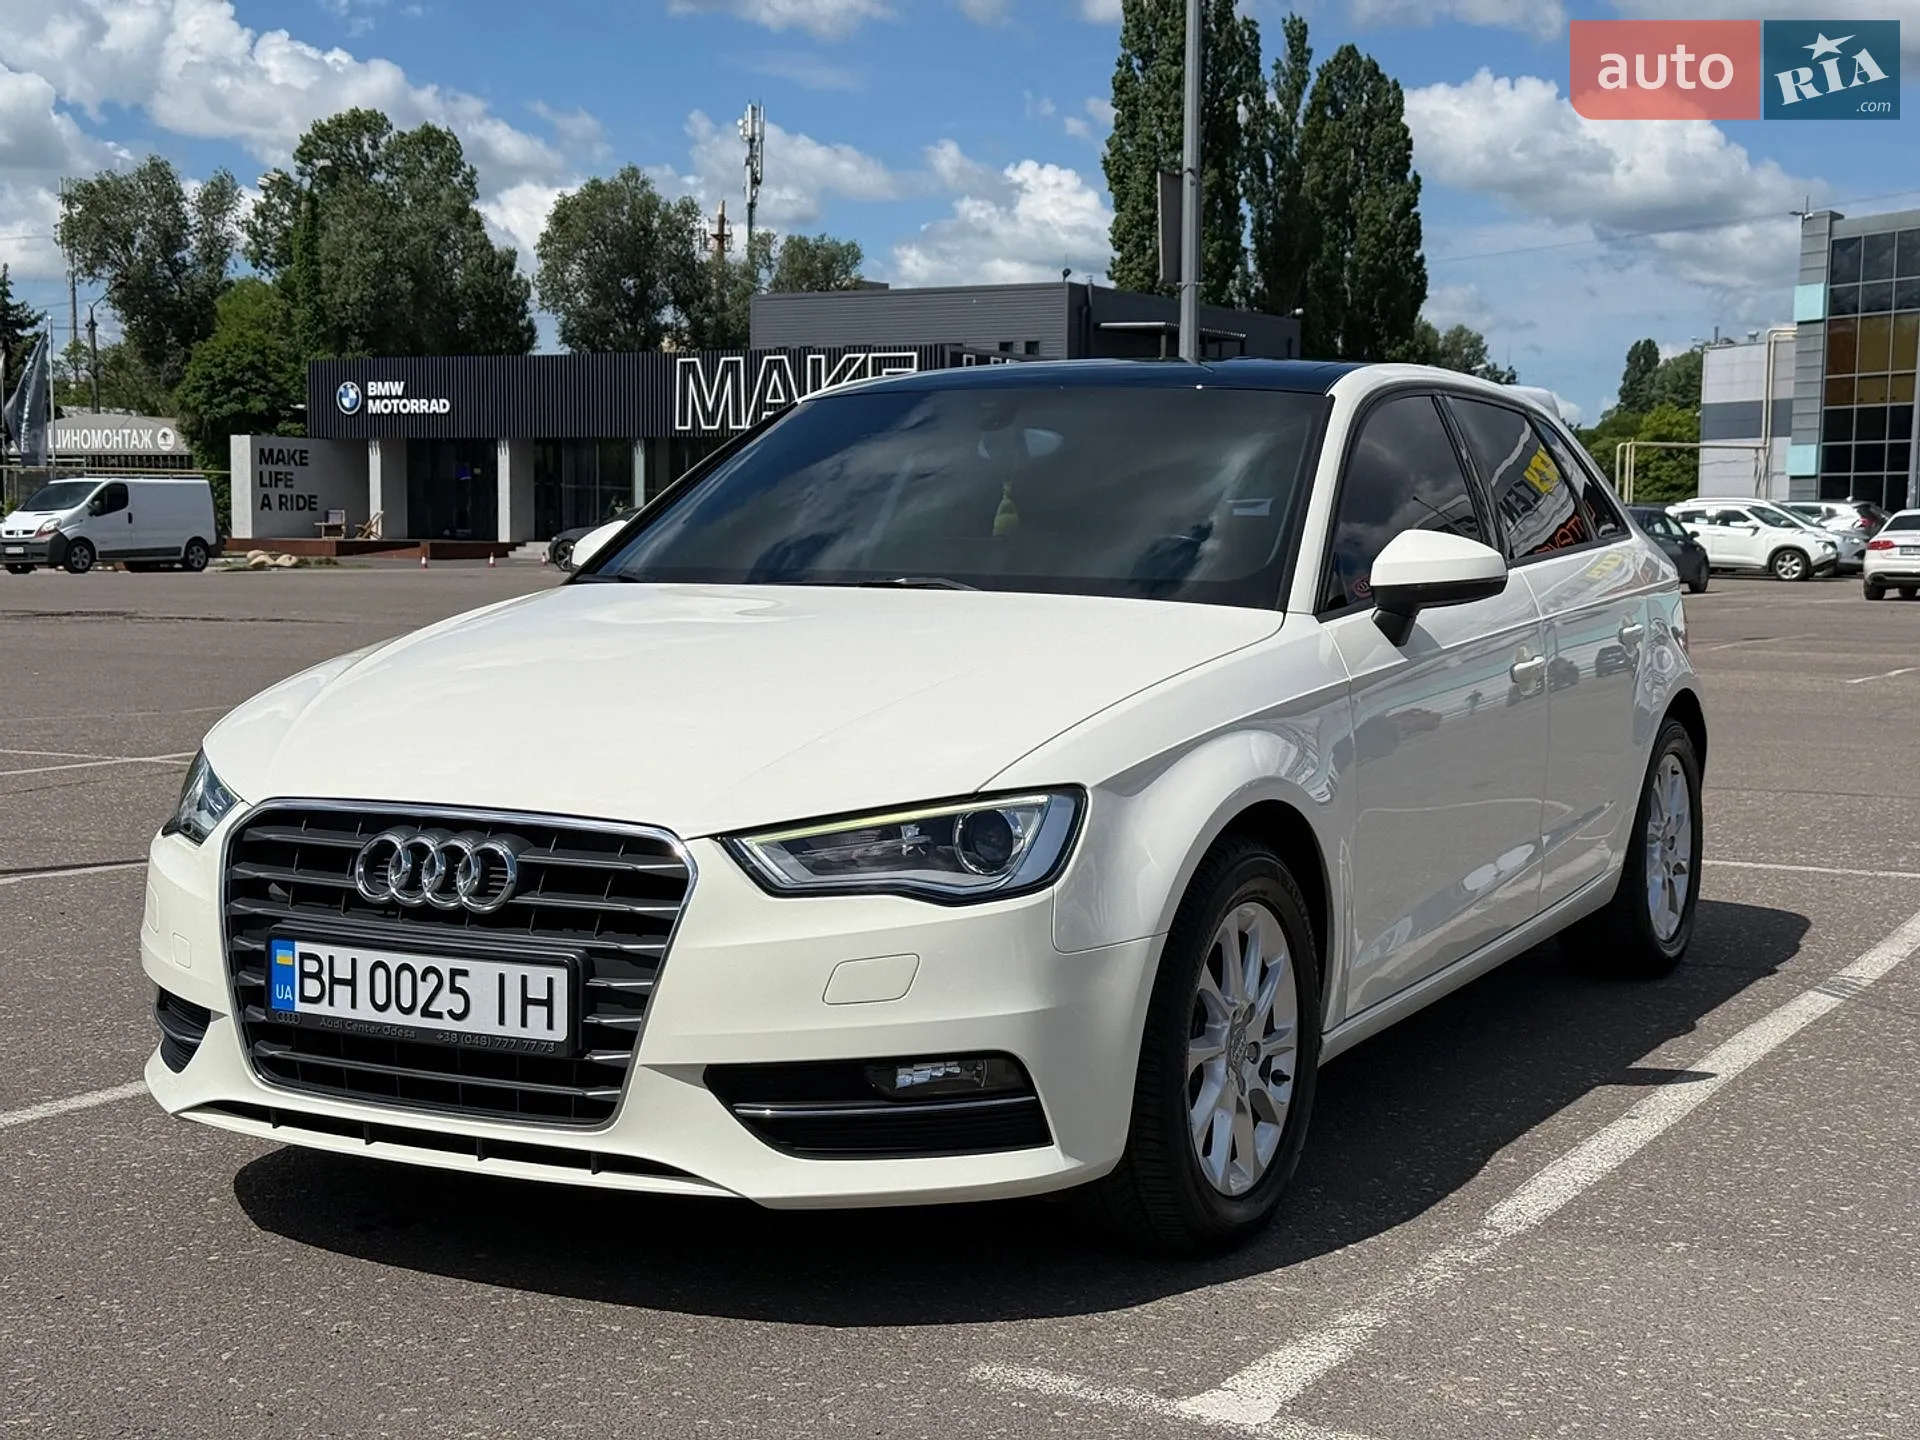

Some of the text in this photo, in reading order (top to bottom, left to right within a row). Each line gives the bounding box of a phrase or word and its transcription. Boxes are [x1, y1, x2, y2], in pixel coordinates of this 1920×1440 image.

[367, 381, 405, 396] BMW
[367, 398, 450, 414] MOTORRAD
[258, 447, 309, 466] MAKE
[258, 470, 294, 488] LIFE
[259, 493, 318, 511] A RIDE
[275, 983, 293, 1001] UA
[298, 951, 554, 1031] BH 0025 IH
[320, 1017, 343, 1030] Audi
[345, 1020, 381, 1034] Center
[494, 1037, 517, 1050] 777
[522, 1040, 538, 1051] 77
